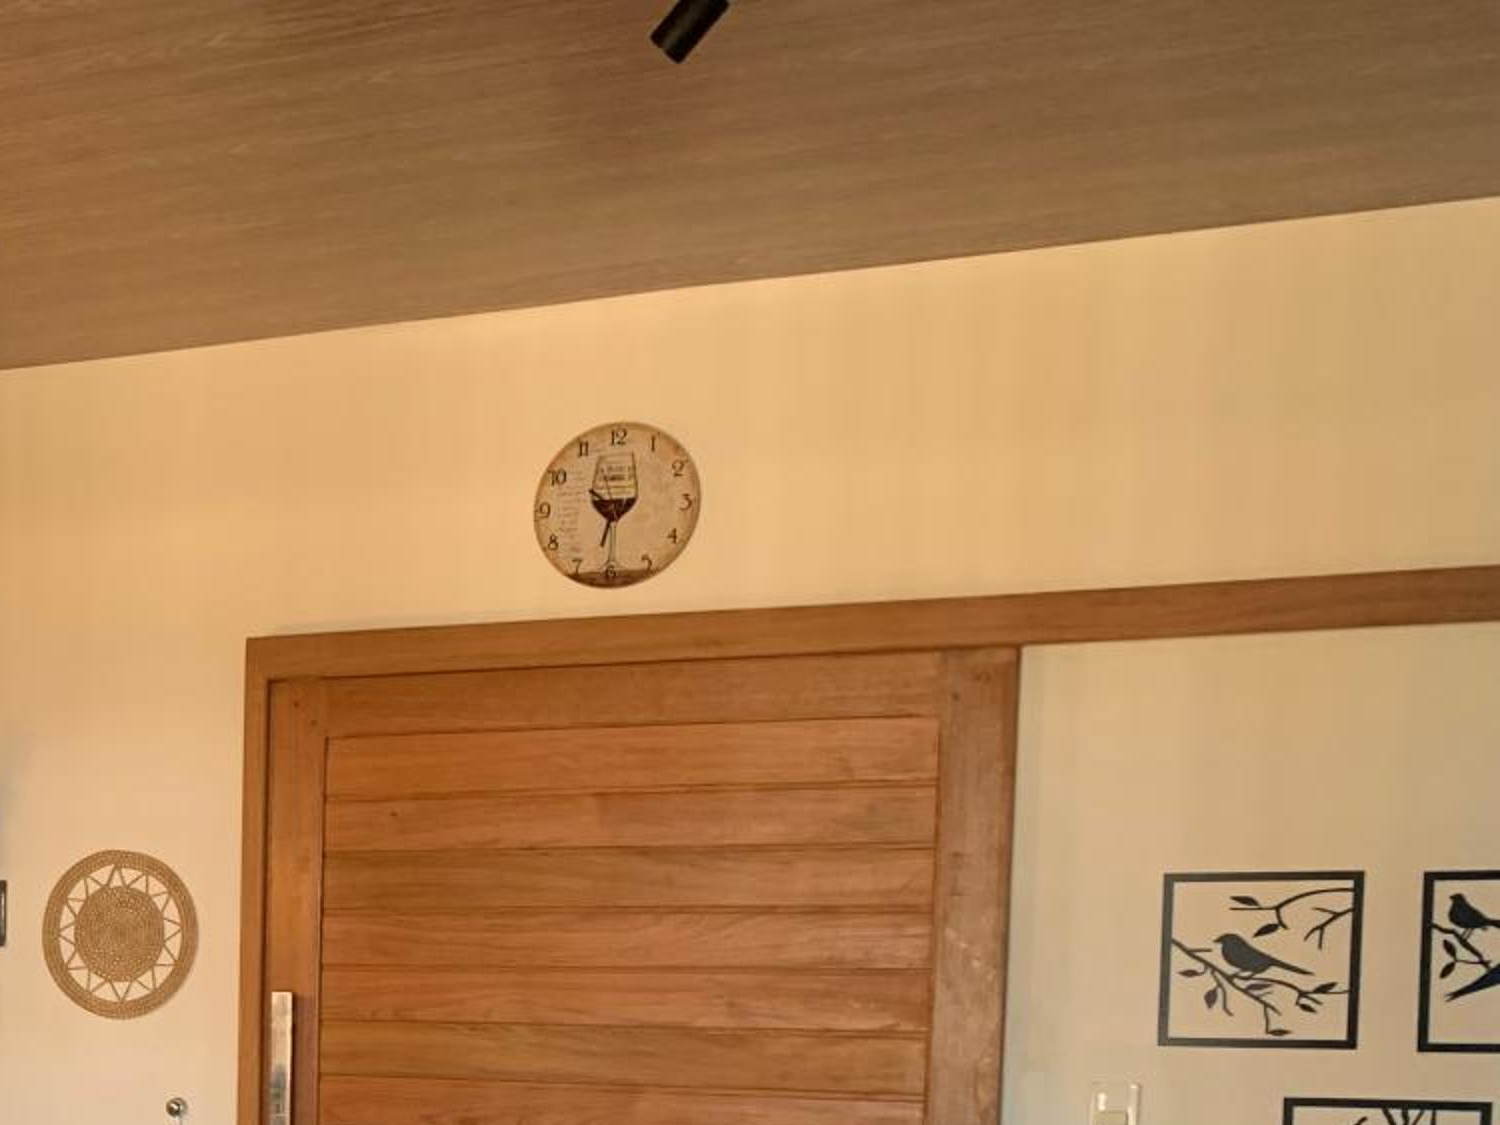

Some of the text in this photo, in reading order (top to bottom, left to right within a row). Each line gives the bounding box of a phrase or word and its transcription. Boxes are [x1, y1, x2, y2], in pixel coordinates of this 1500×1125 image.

[611, 428, 627, 446] 12
[578, 441, 589, 457] 11
[671, 460, 684, 477] 2
[549, 469, 567, 486] 10
[539, 502, 551, 519] 9
[679, 494, 693, 511] 3
[548, 534, 558, 551] 8
[668, 528, 677, 544] 4
[572, 558, 582, 575] 7
[604, 565, 616, 578] 6
